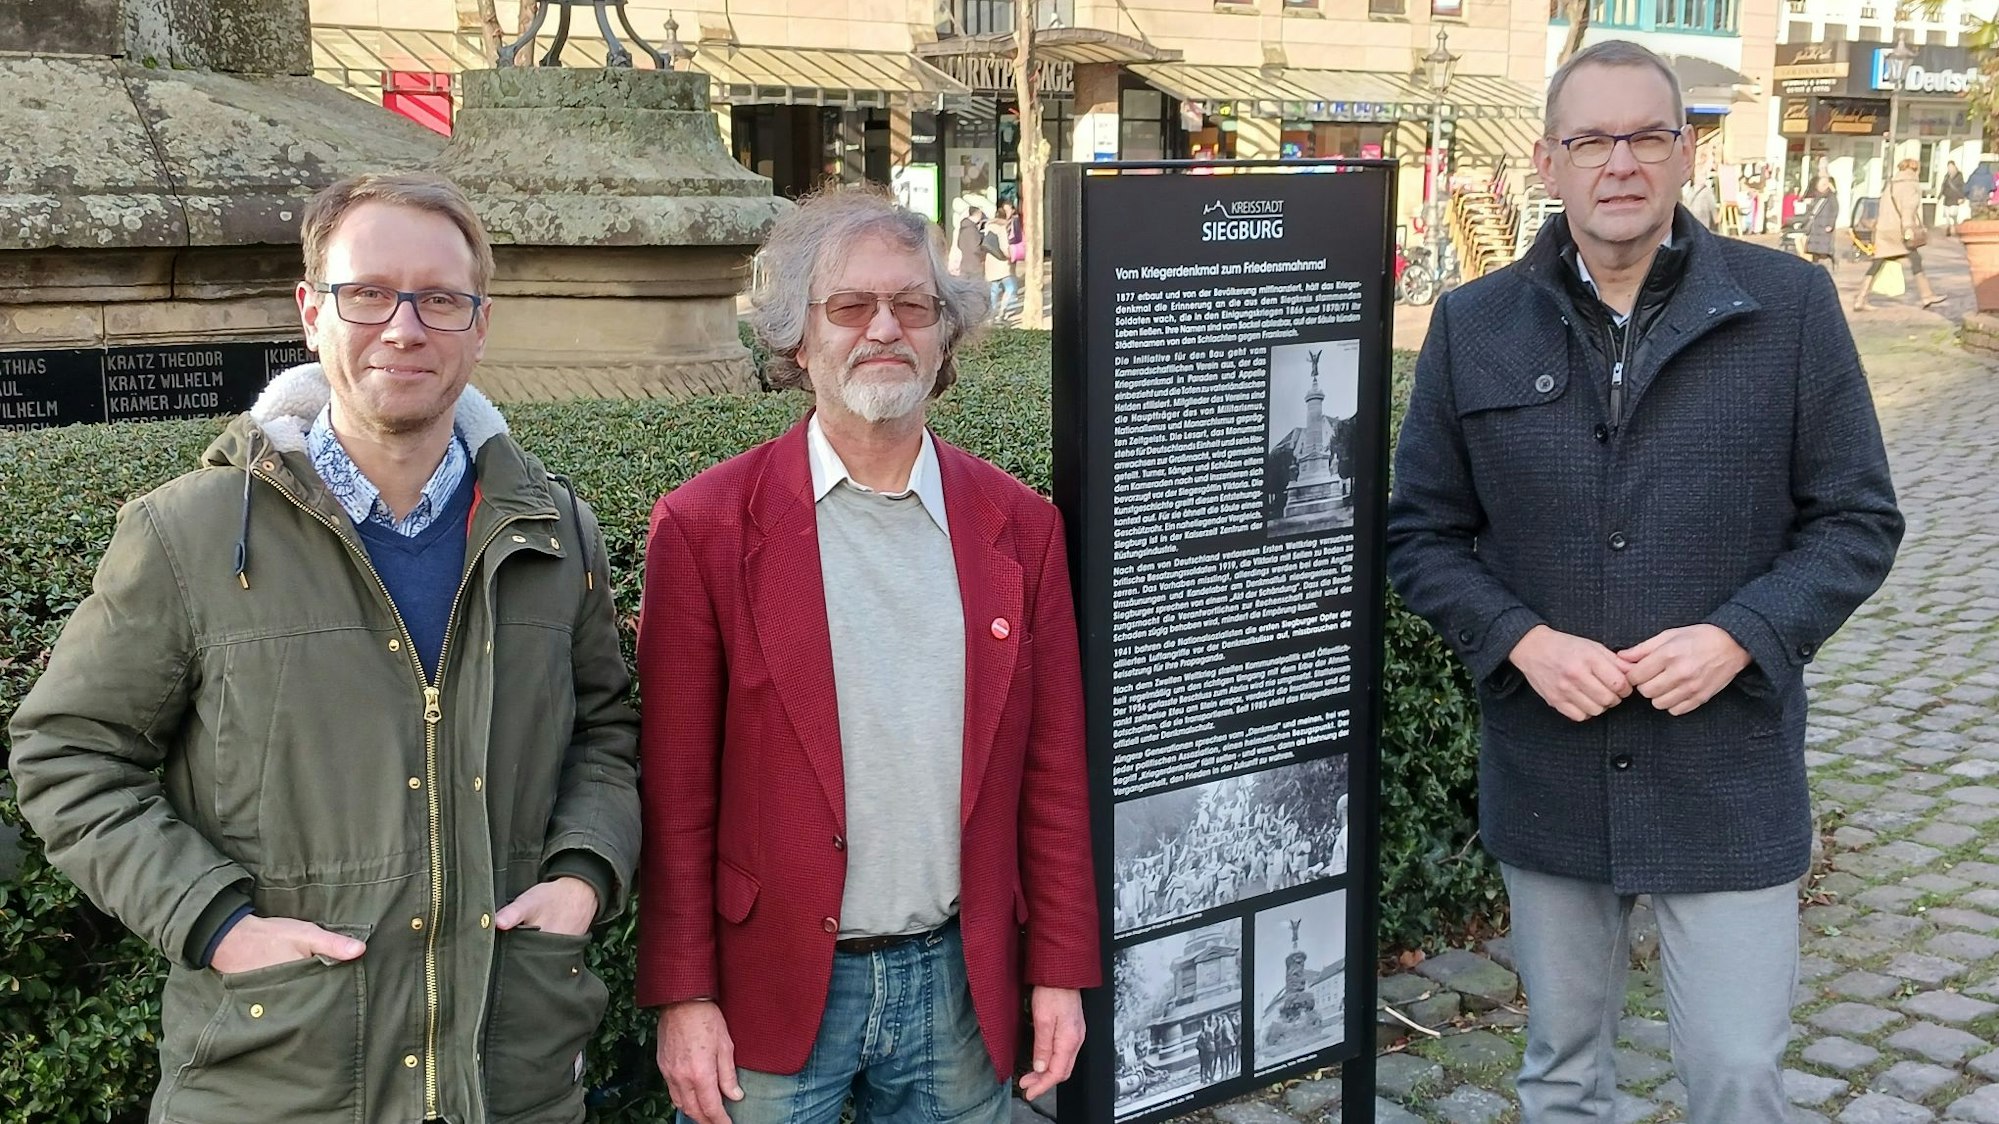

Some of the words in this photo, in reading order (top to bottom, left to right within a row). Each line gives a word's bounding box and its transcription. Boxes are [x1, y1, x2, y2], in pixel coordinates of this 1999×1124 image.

[1231, 200, 1284, 214] KREISSTADT
[1202, 220, 1284, 241] SIEGBURG
[1115, 267, 1139, 280] Vom
[1141, 263, 1219, 280] Kriegerdenkmal
[1221, 264, 1242, 275] zum
[1243, 258, 1326, 273] Friedensmahnmal
[1116, 292, 1135, 302] 1877
[1137, 291, 1163, 301] erbaut
[1165, 290, 1180, 299] und
[1198, 289, 1212, 297] der
[1321, 282, 1334, 290] das
[1115, 303, 1151, 314] denkmal
[1154, 303, 1167, 312] die
[1171, 301, 1212, 311] Erinnerung
[1228, 298, 1241, 307] die
[1244, 298, 1258, 306] aus
[1260, 296, 1277, 305] dem
[1115, 316, 1151, 326] Soldaten
[1153, 314, 1176, 323] wach,
[1179, 313, 1192, 322] die
[1204, 311, 1219, 320] den
[1286, 305, 1304, 314] 1866
[1305, 304, 1320, 314] und
[1115, 328, 1138, 338] Leben
[1165, 326, 1179, 334] Ihre
[1180, 325, 1206, 333] Namen
[1166, 338, 1180, 346] von
[1181, 336, 1196, 344] den
[107, 353, 155, 371] KRATZ
[159, 351, 223, 368] THEODOR
[1115, 356, 1129, 366] Die
[1133, 354, 1170, 364] Initiative
[1174, 352, 1186, 361] für
[1189, 351, 1205, 360] den
[1209, 349, 1224, 358] Bau
[1227, 347, 1246, 359] geht
[1196, 361, 1218, 370] Verein
[1220, 361, 1236, 369] aus,
[1238, 358, 1251, 367] der
[1252, 357, 1266, 366] das
[0, 358, 47, 375] THIAS
[109, 374, 156, 391] KRATZ
[160, 371, 224, 389] WILHELM
[1115, 375, 1173, 390] Kriegerdenkmal
[1187, 373, 1218, 382] Paraden
[1221, 370, 1236, 380] und
[0, 400, 58, 419] ILHELM
[110, 392, 169, 413] KRÄMER
[173, 392, 219, 410] JACOB
